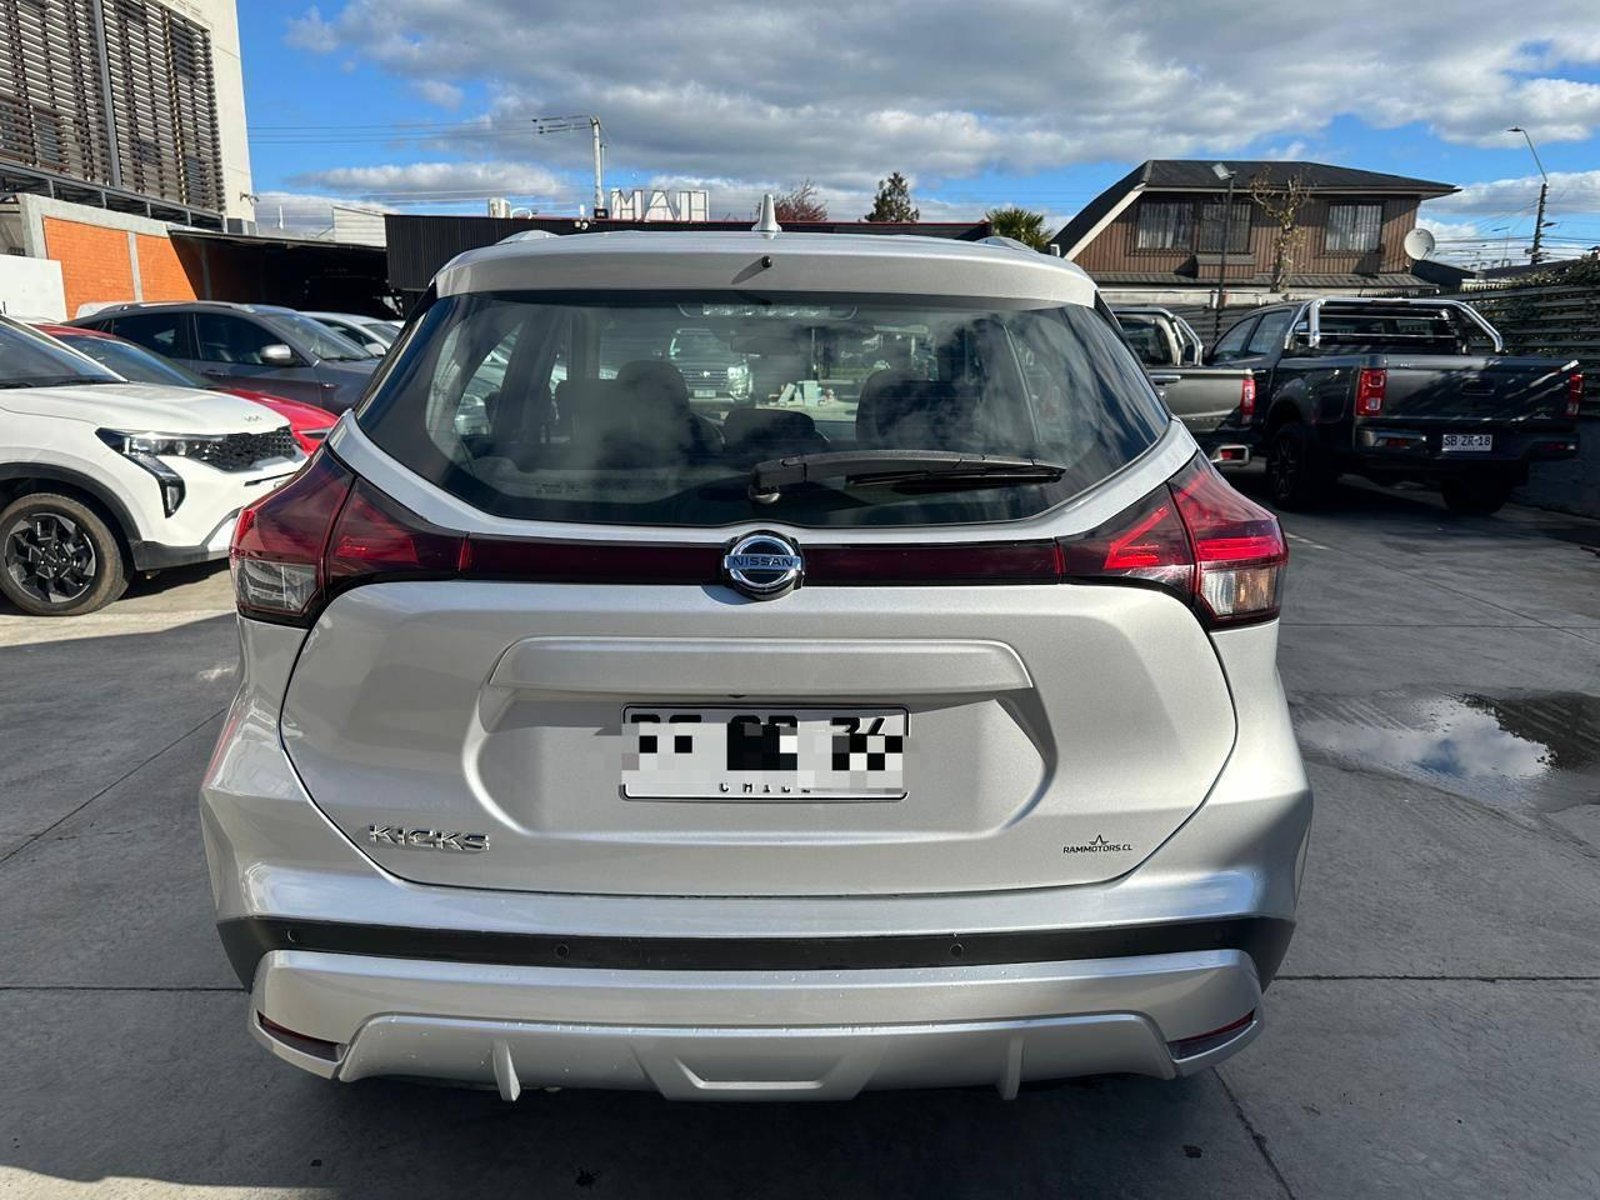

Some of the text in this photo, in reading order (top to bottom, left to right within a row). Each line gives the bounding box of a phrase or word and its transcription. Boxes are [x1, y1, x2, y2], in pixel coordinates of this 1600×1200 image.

[732, 556, 794, 568] NISSAN
[369, 825, 490, 852] KICKS
[1063, 843, 1133, 854] RAMMOTORS.CL
